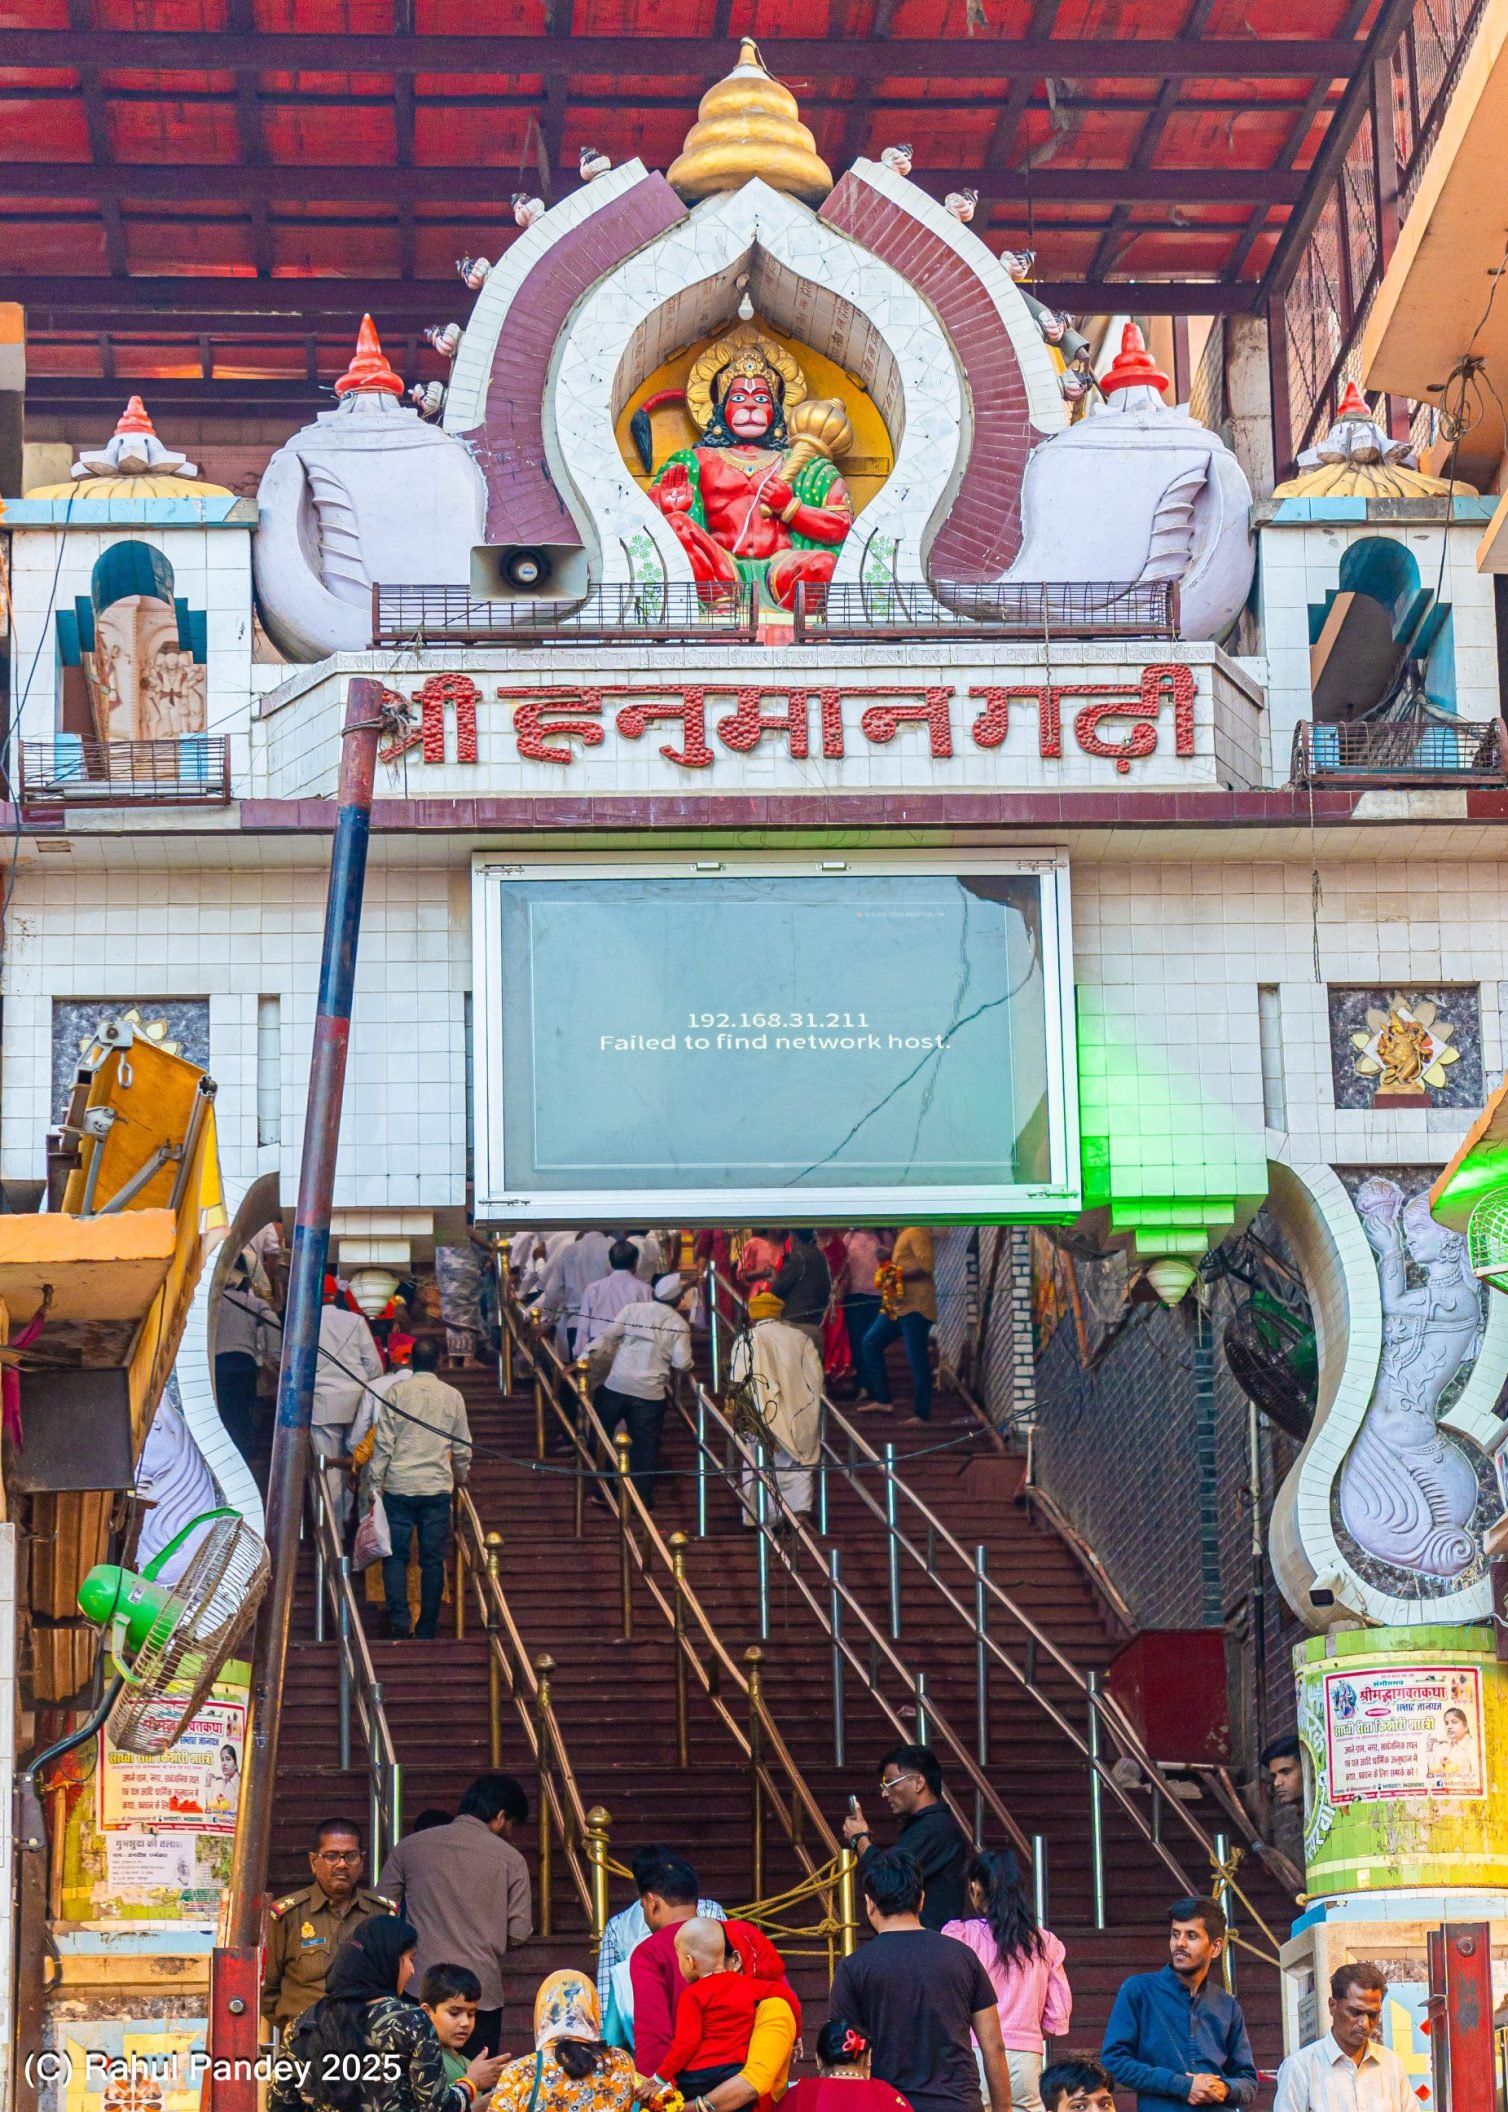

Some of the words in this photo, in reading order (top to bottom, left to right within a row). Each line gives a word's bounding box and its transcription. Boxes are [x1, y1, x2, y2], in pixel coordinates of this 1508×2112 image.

[497, 684, 956, 769] हनुमान
[969, 663, 1198, 775] गढ़ी
[687, 1012, 870, 1029] 192.168.31.211
[600, 1034, 677, 1051] Failed
[684, 1035, 710, 1050] to
[716, 1033, 768, 1050] find
[775, 1033, 882, 1050] network
[888, 1033, 952, 1050] host.
